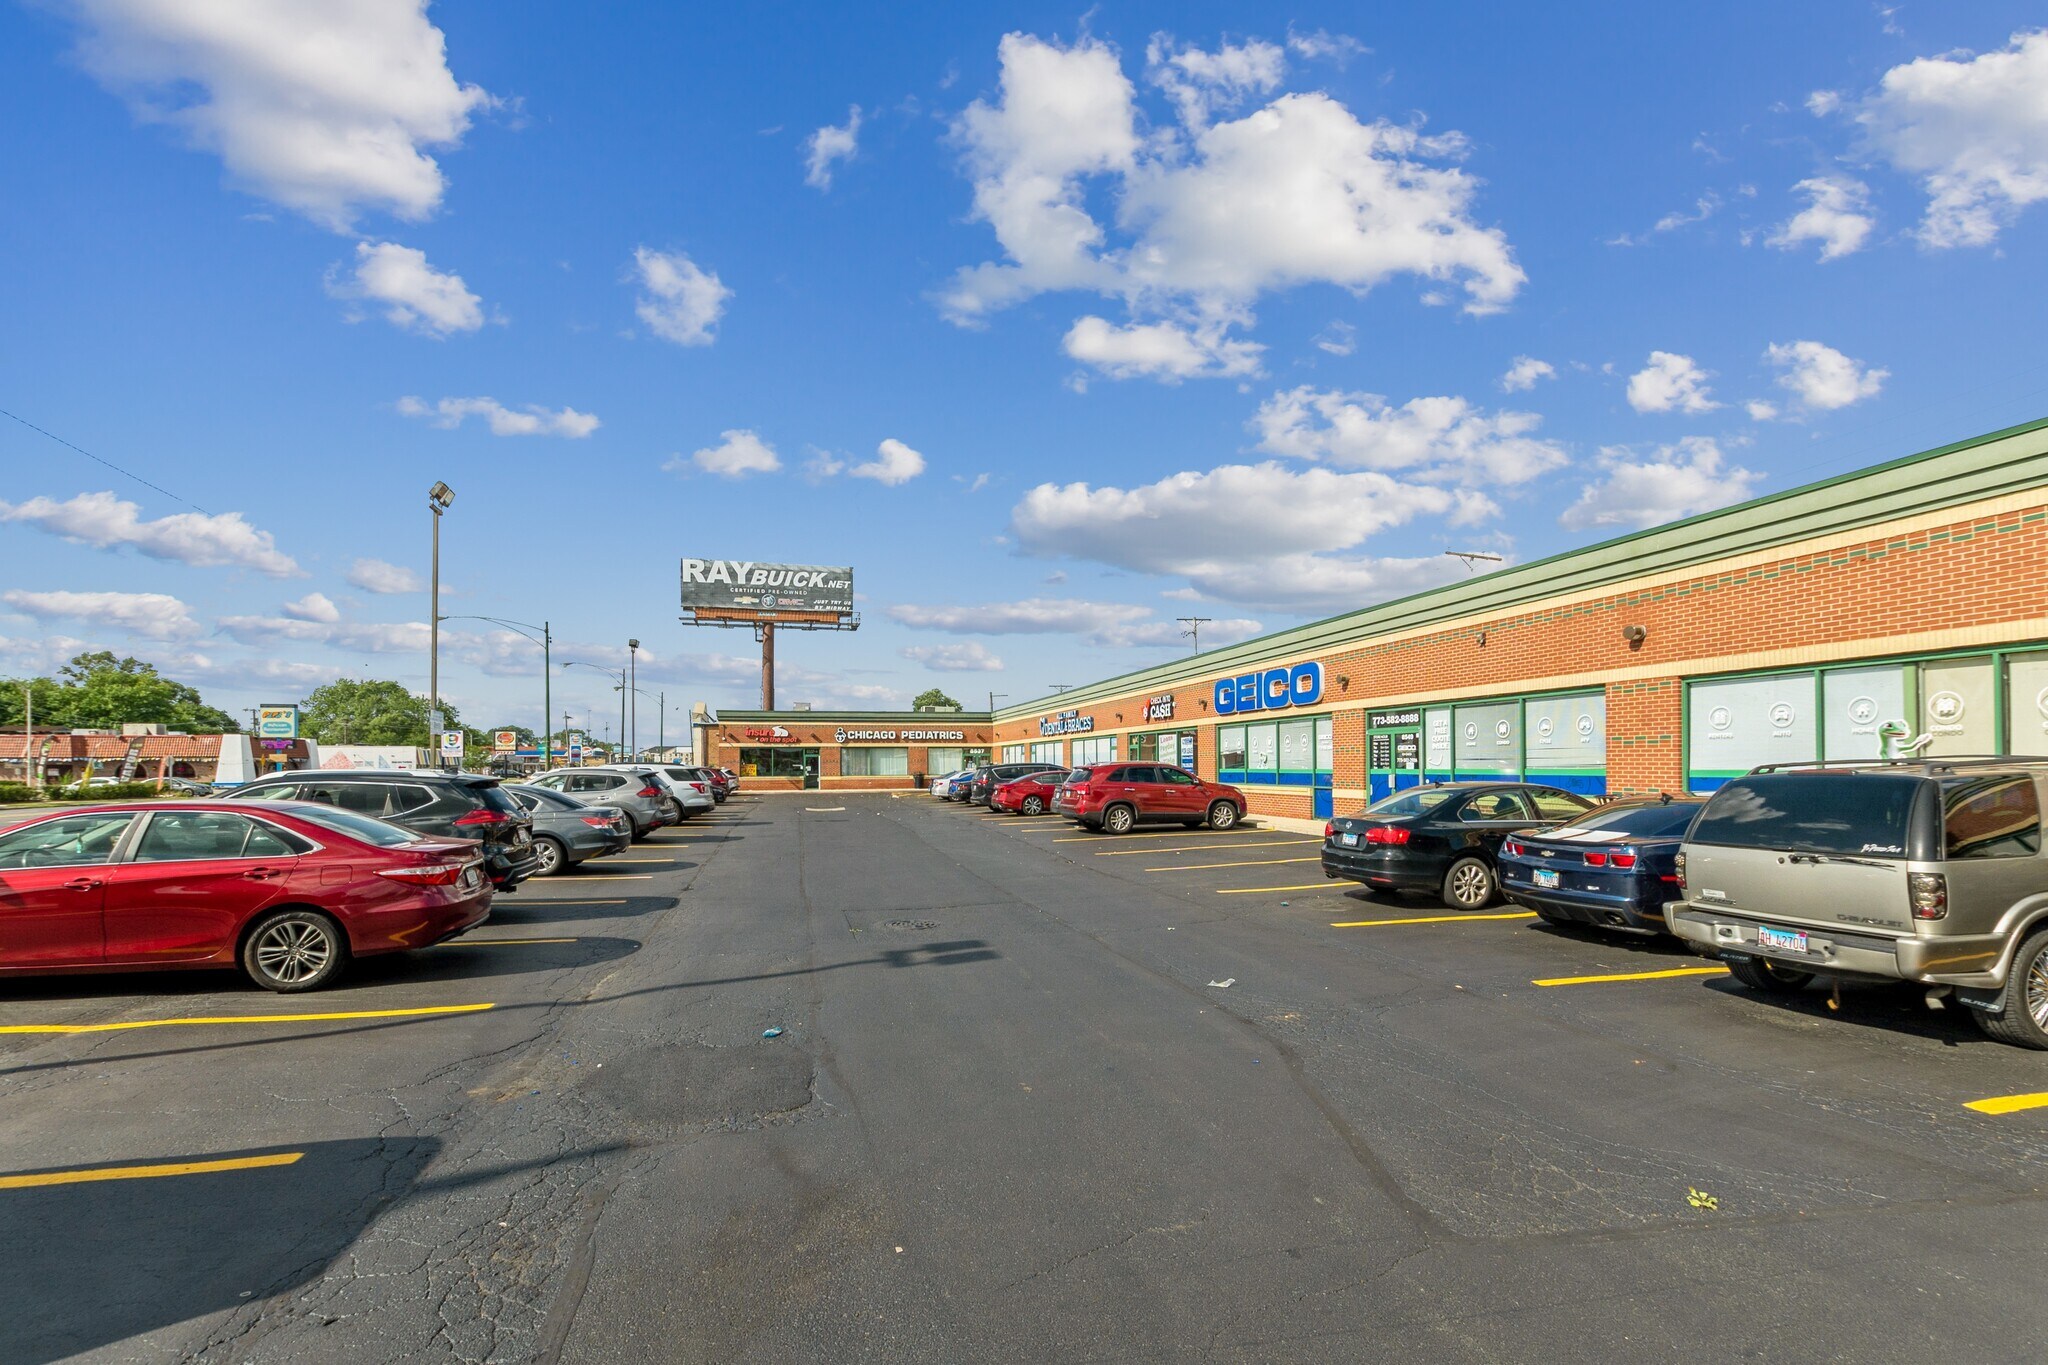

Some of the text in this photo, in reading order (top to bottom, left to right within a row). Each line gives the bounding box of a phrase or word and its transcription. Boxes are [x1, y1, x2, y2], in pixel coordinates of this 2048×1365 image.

[777, 598, 804, 606] GMC
[1214, 661, 1324, 716] GEICO
[1150, 696, 1162, 705] CHECK
[1068, 716, 1092, 732] BRACES
[1372, 714, 1419, 725] 773-582-8888
[746, 726, 775, 736] insure
[847, 730, 964, 740] CHICAGO PEDIATRICS
[1772, 730, 1792, 738] AUTO
[1852, 726, 1876, 735] HOME
[1837, 914, 1904, 927] CHEVROLET
[1760, 932, 1806, 950] AH 42704
[1960, 998, 2000, 1010] BLAZER
